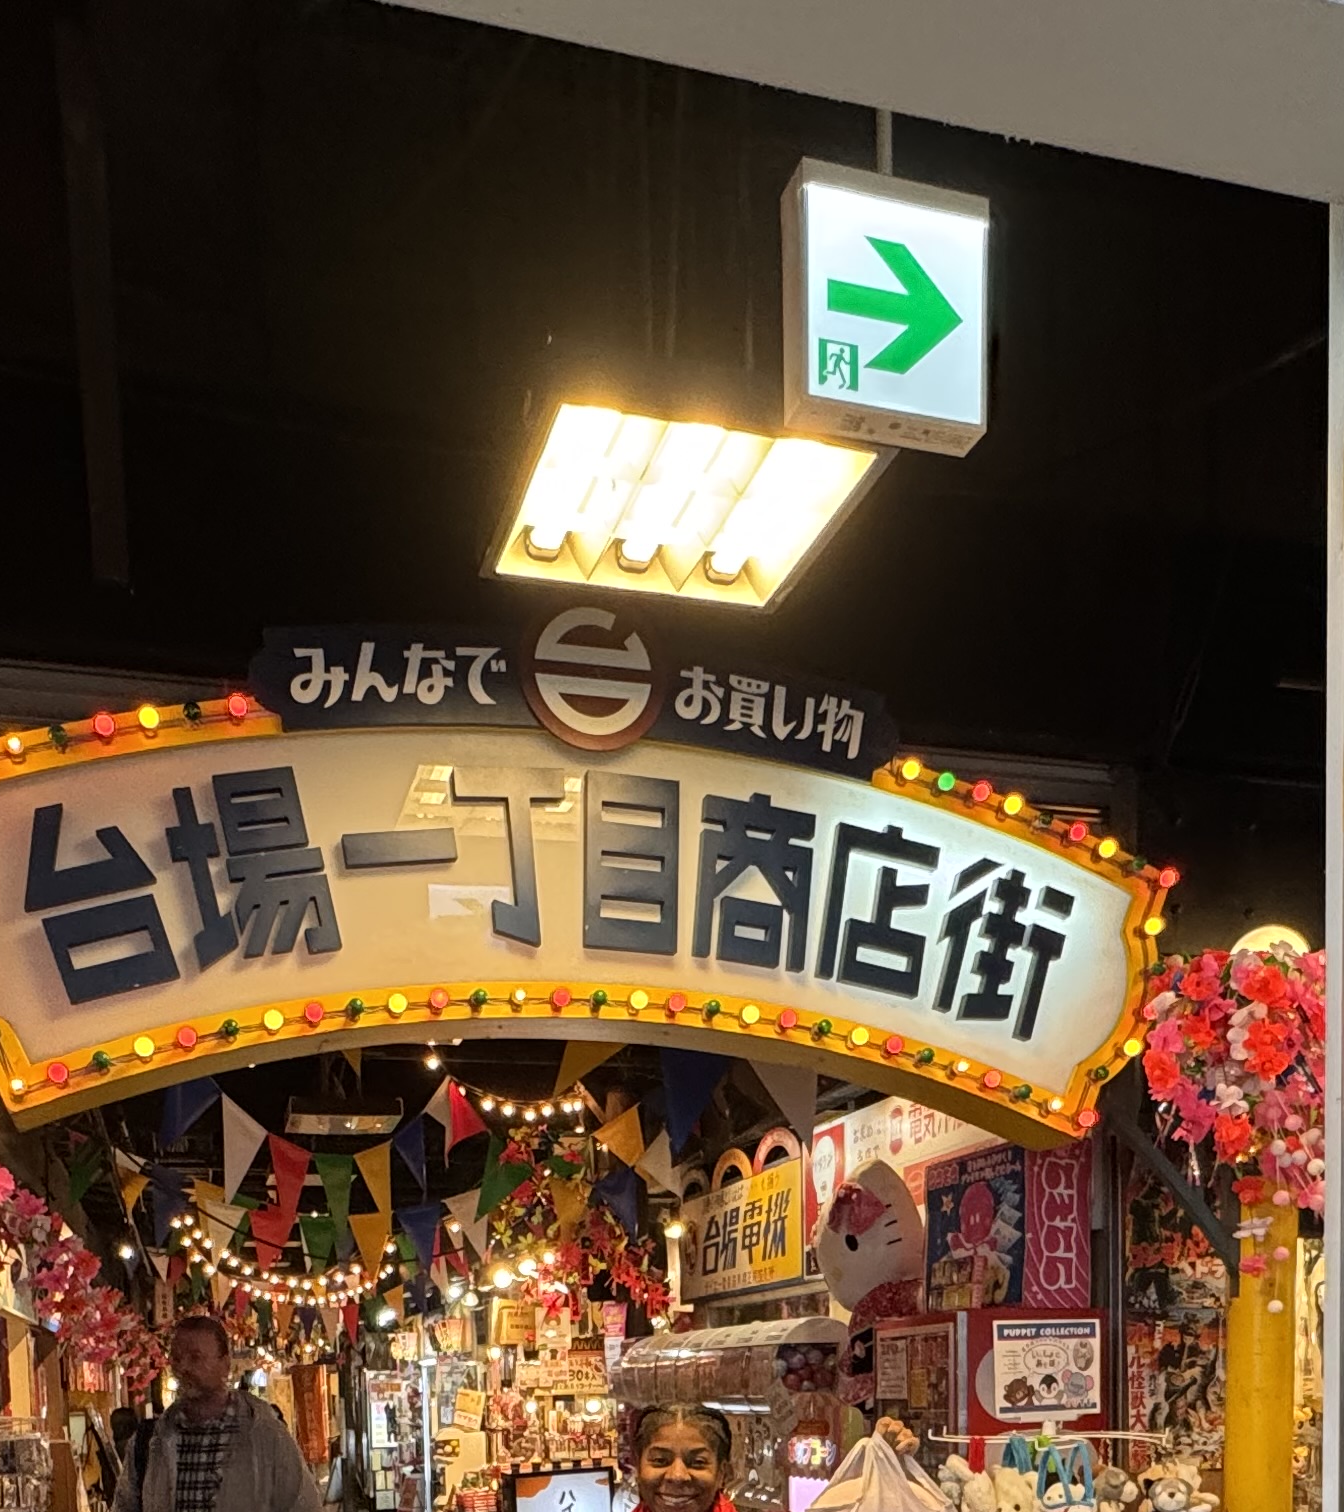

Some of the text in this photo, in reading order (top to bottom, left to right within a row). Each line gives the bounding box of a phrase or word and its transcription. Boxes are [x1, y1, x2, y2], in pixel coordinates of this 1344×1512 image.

[289, 641, 507, 707] みんなで
[674, 665, 866, 760] お買い物
[23, 765, 1077, 1043] 台場一丁目商店街
[702, 1187, 792, 1277] 台場電機
[1003, 1326, 1091, 1337] PUPPET COLLECTION
